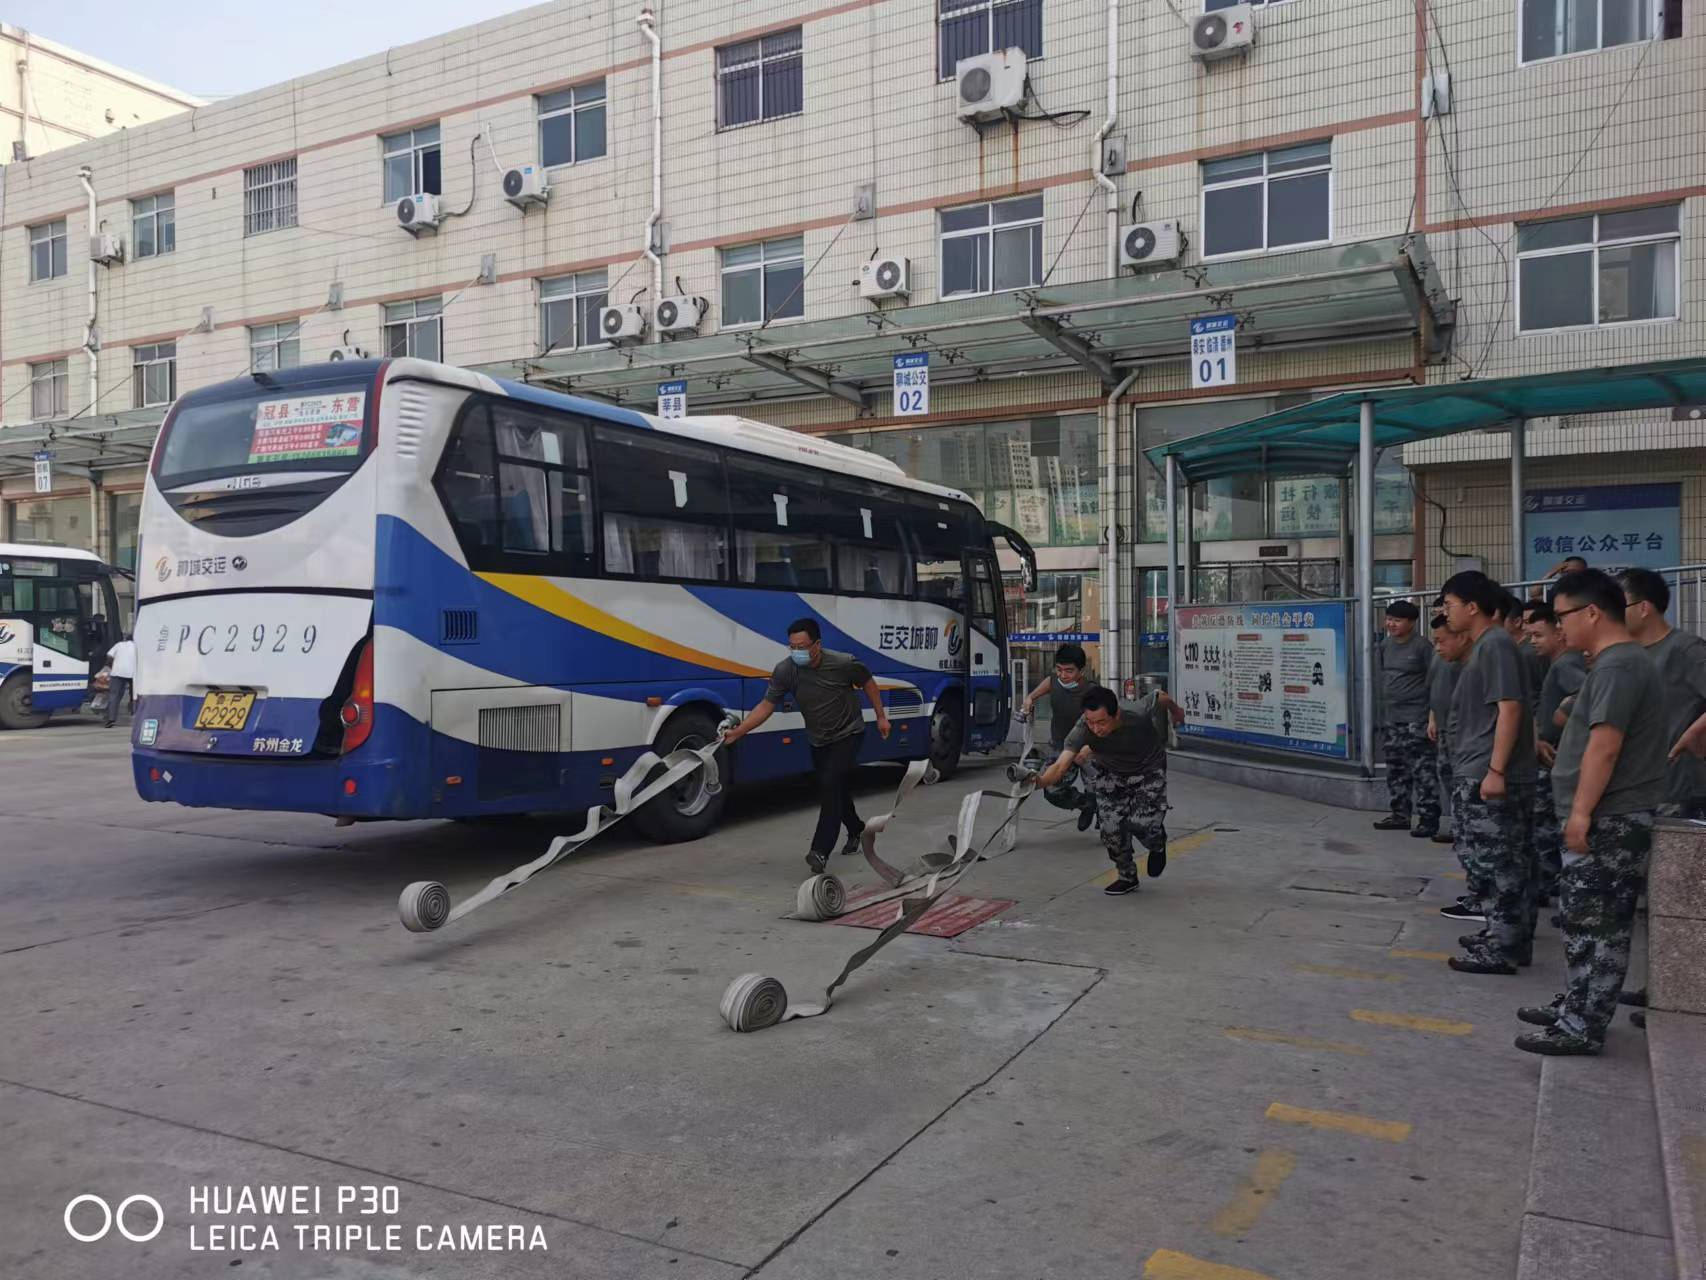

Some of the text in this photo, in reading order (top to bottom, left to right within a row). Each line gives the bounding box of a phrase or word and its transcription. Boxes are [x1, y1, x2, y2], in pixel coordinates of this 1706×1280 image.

[1199, 357, 1226, 383] 01
[332, 396, 361, 414] 东营
[900, 390, 923, 412] 02
[1534, 532, 1664, 554] 微信公众平台
[200, 706, 246, 726] C2929
[252, 737, 303, 753] 苏州金龙
